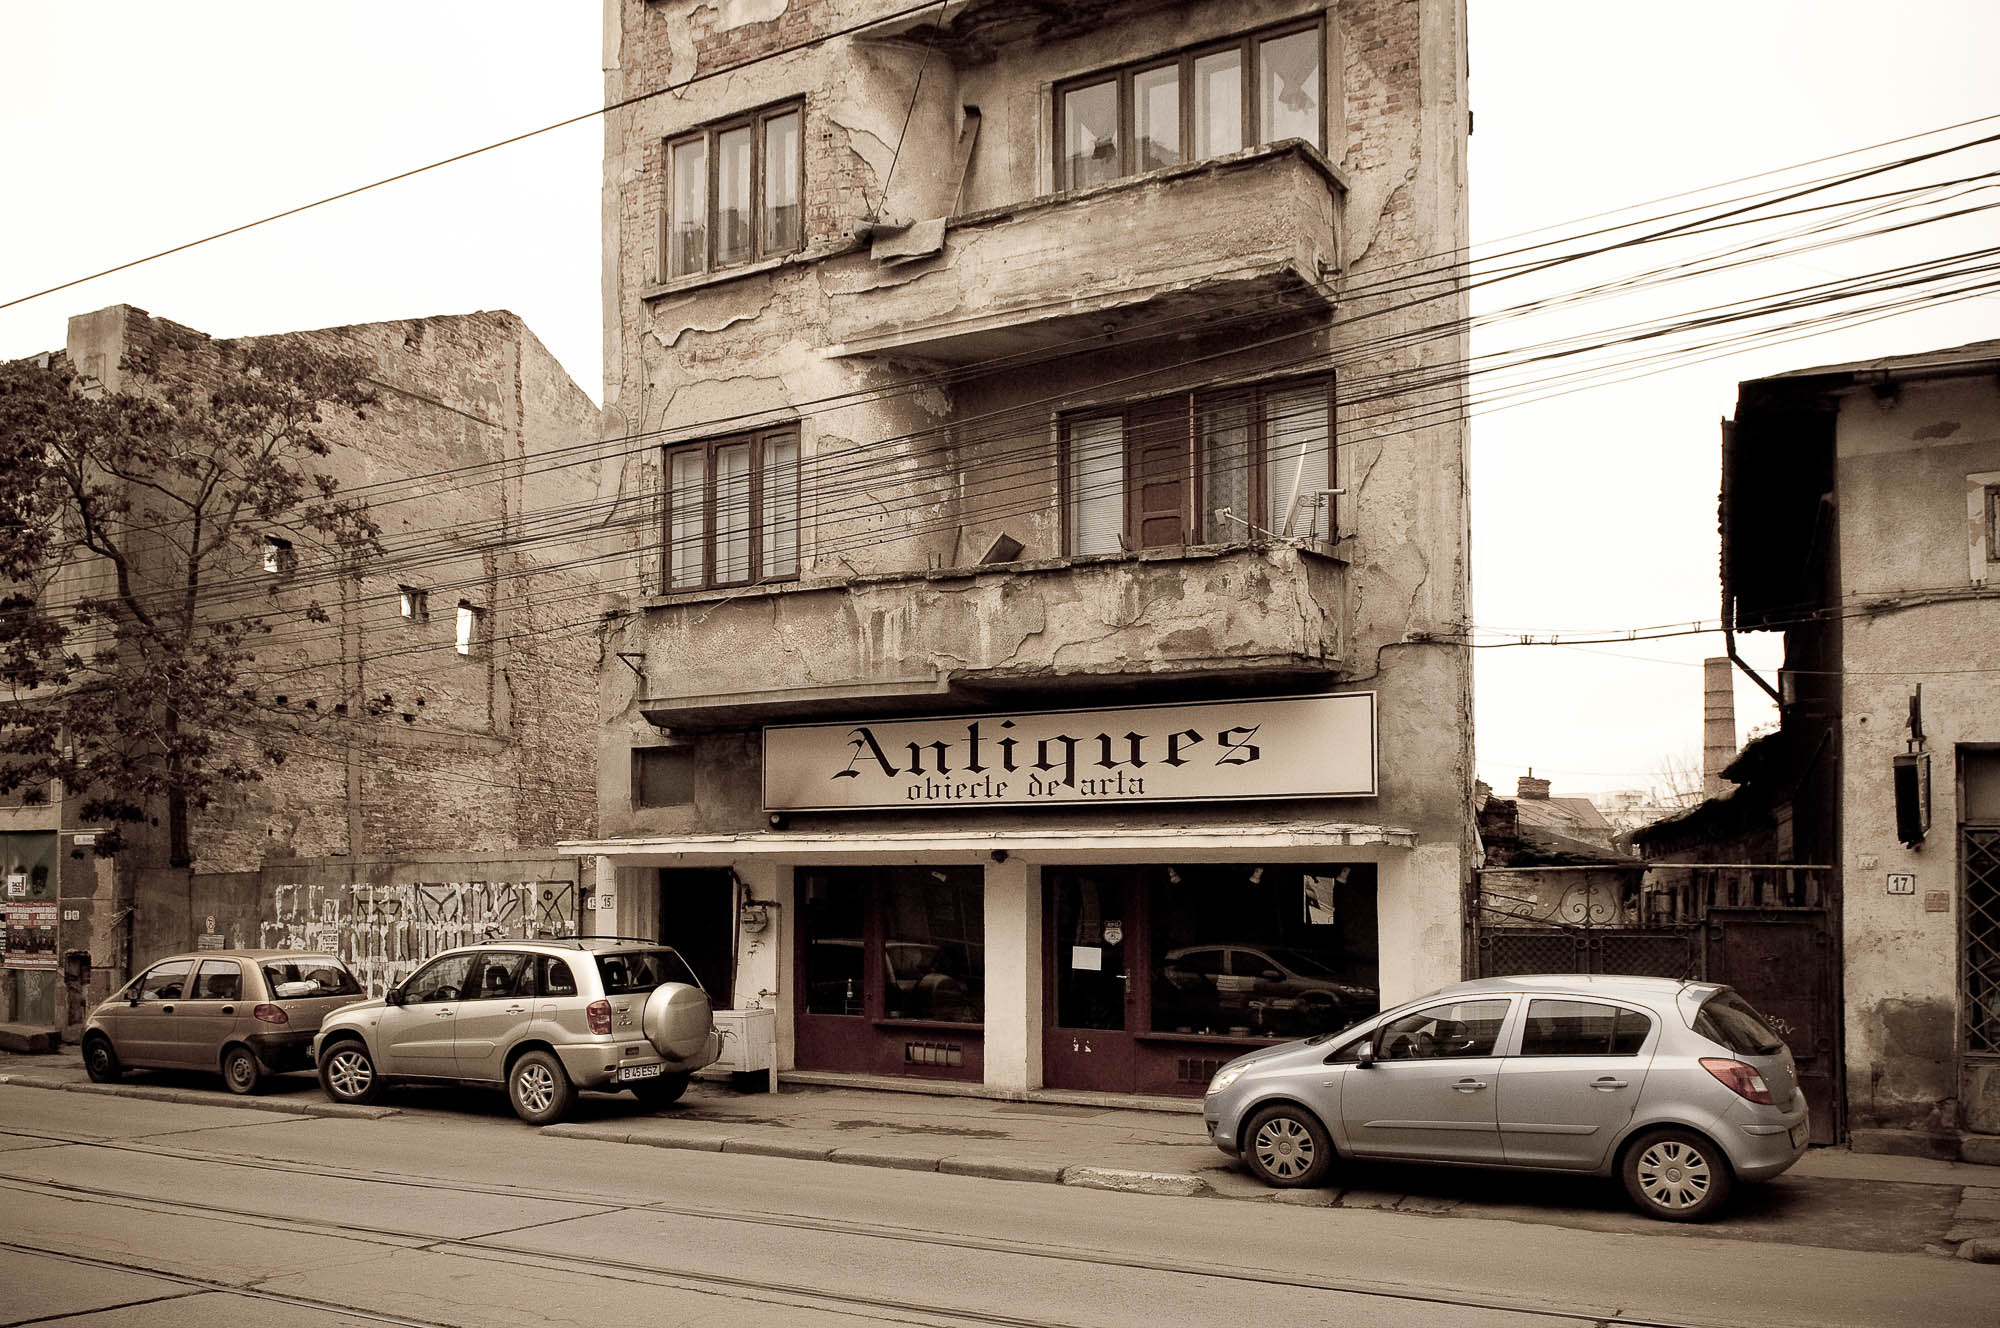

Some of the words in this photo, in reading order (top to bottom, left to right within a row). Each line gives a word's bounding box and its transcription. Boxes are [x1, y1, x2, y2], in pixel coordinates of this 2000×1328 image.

[830, 719, 1262, 788] Antiques
[907, 775, 1008, 801] obiecte
[1027, 772, 1060, 797] de
[1079, 770, 1146, 796] arta
[1893, 877, 1908, 892] 17
[603, 896, 612, 908] 15
[624, 1068, 631, 1079] B
[632, 1067, 641, 1078] 45
